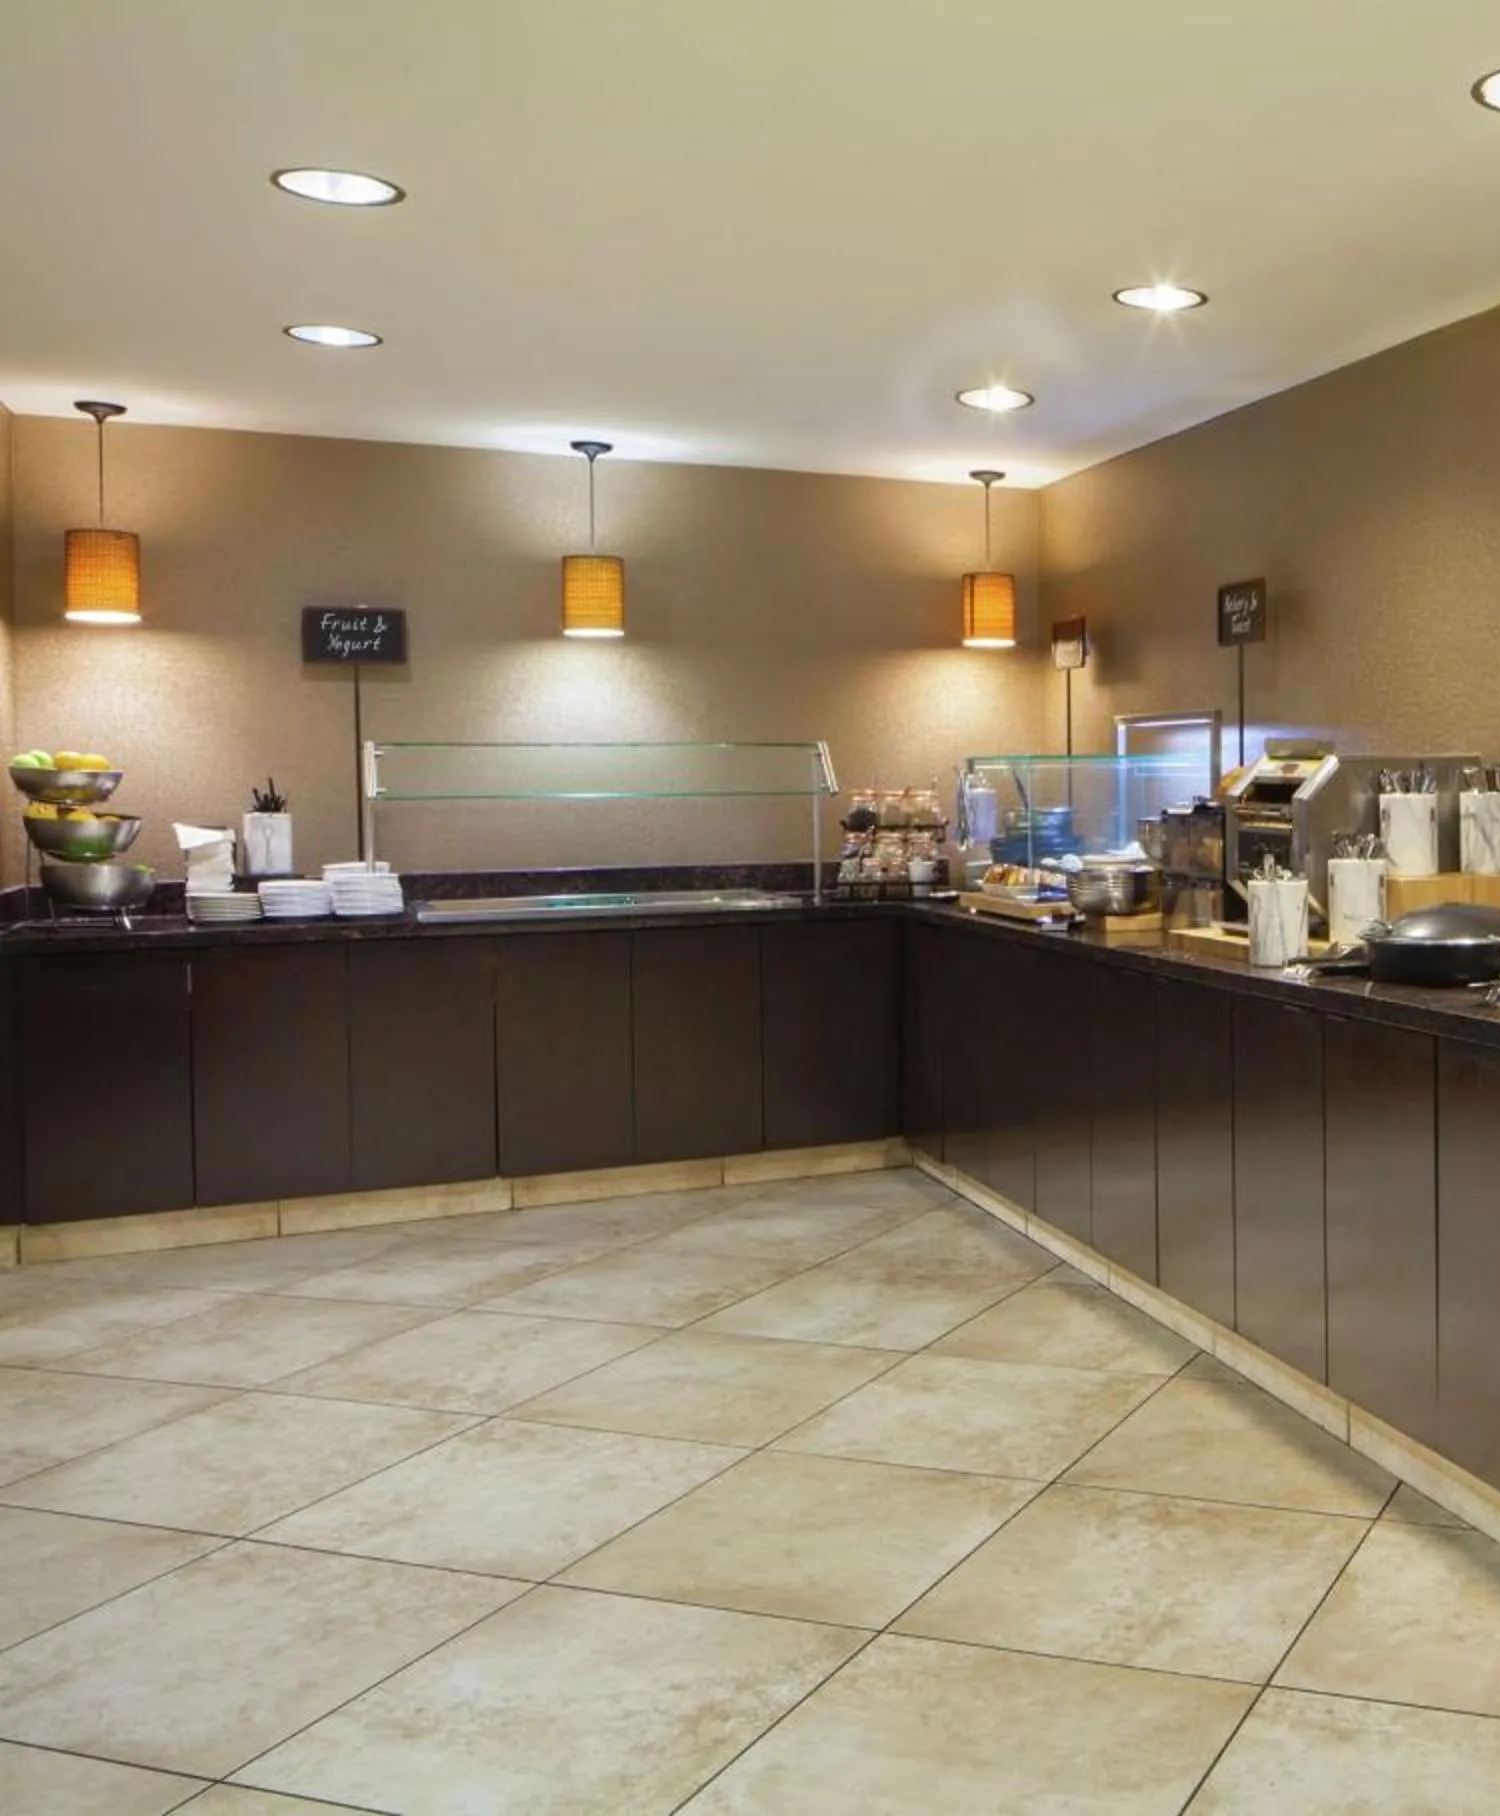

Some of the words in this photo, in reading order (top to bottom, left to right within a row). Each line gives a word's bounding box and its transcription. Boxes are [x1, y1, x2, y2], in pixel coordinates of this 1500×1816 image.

[320, 613, 368, 631] Fruit
[373, 614, 388, 633] &
[328, 633, 381, 658] Yogurt
